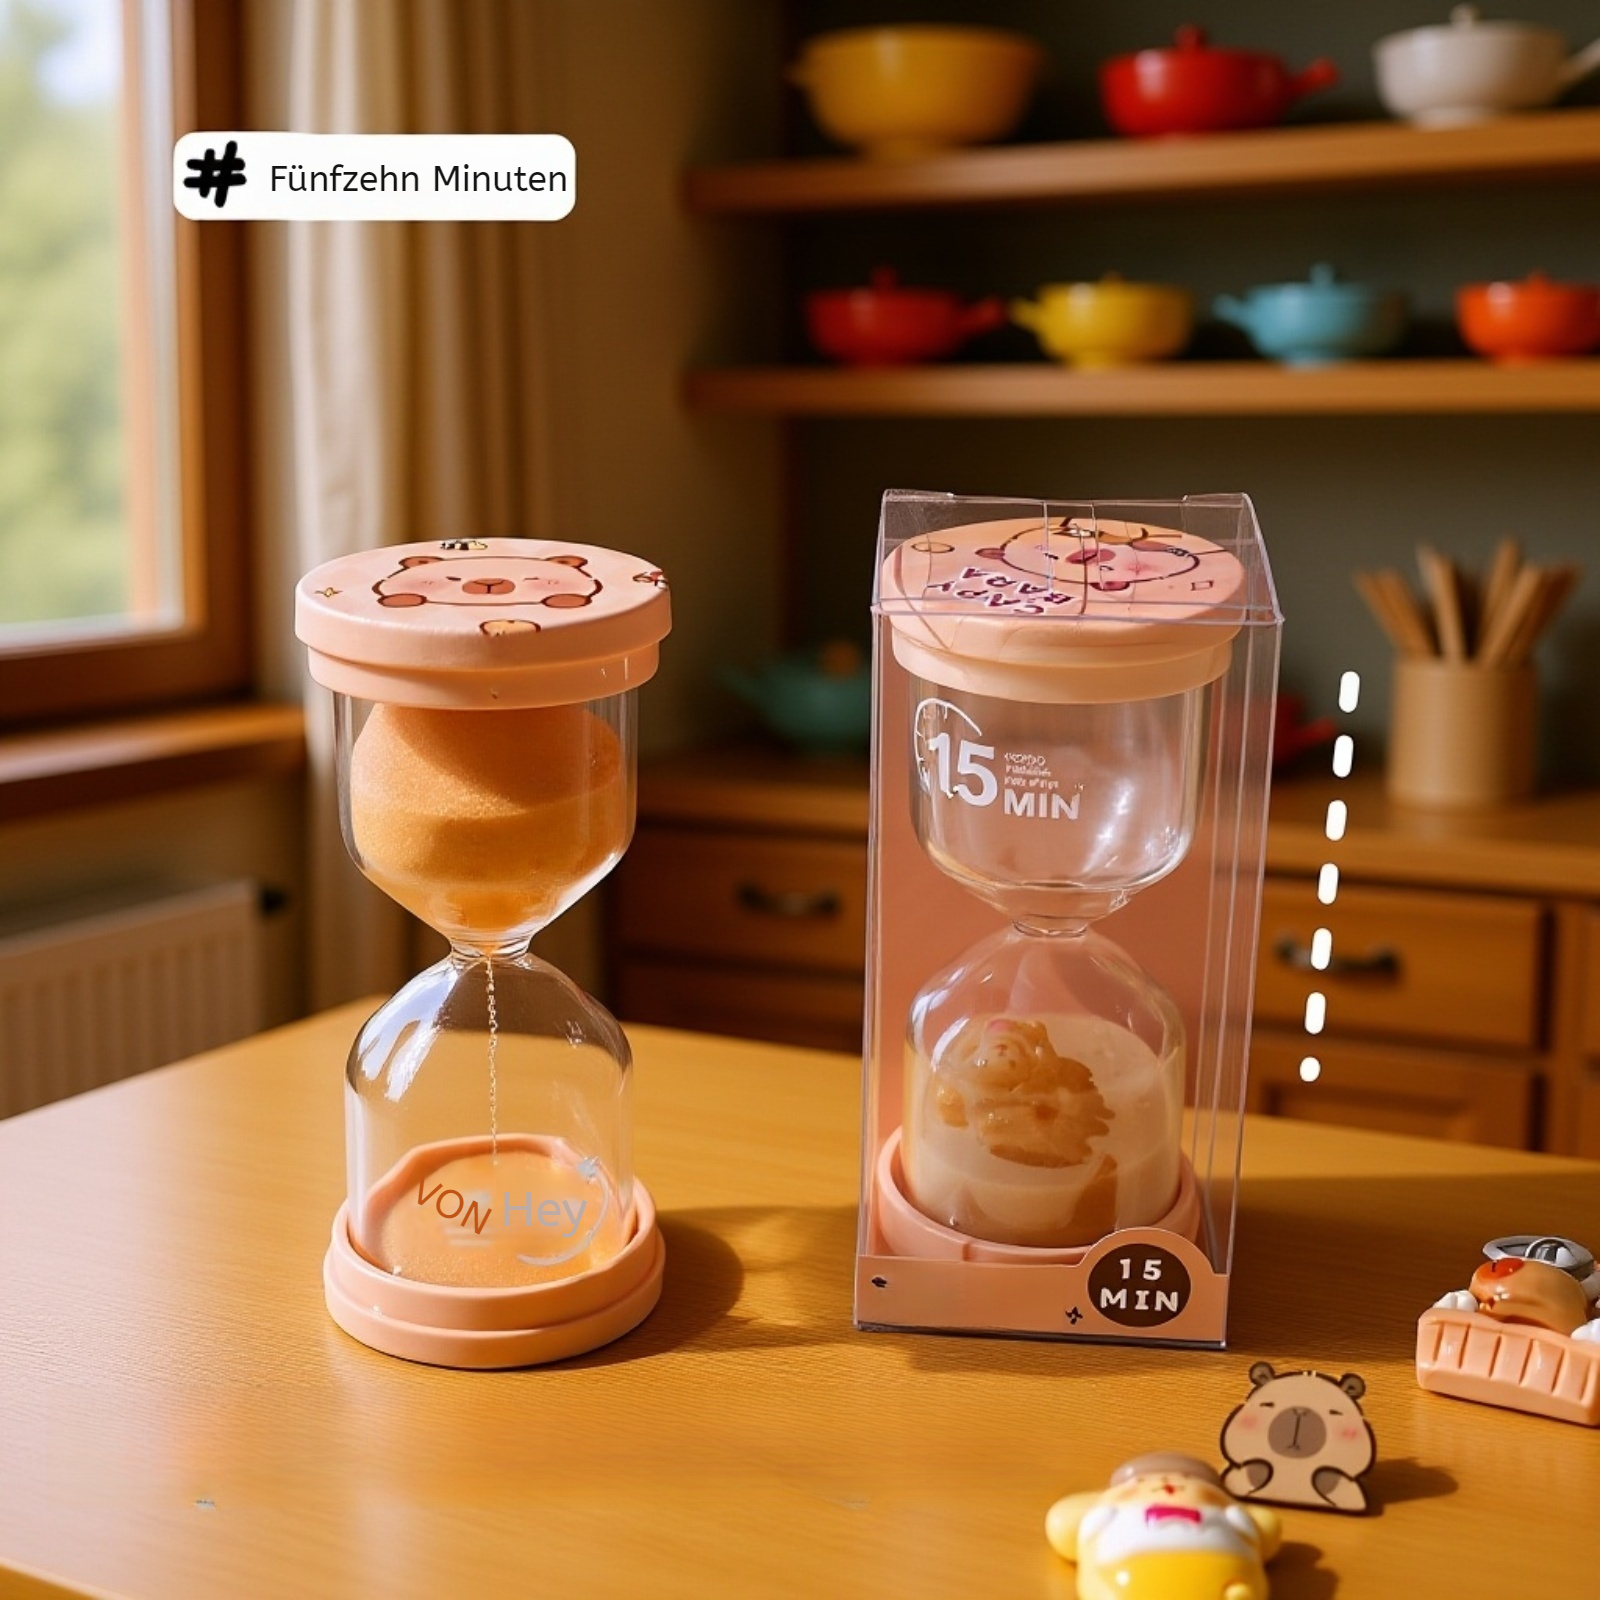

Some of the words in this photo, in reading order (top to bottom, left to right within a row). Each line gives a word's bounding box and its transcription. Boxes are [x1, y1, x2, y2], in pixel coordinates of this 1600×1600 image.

[927, 732, 998, 807] 15
[1004, 788, 1081, 820] MIN
[1100, 1287, 1179, 1312] MIN
